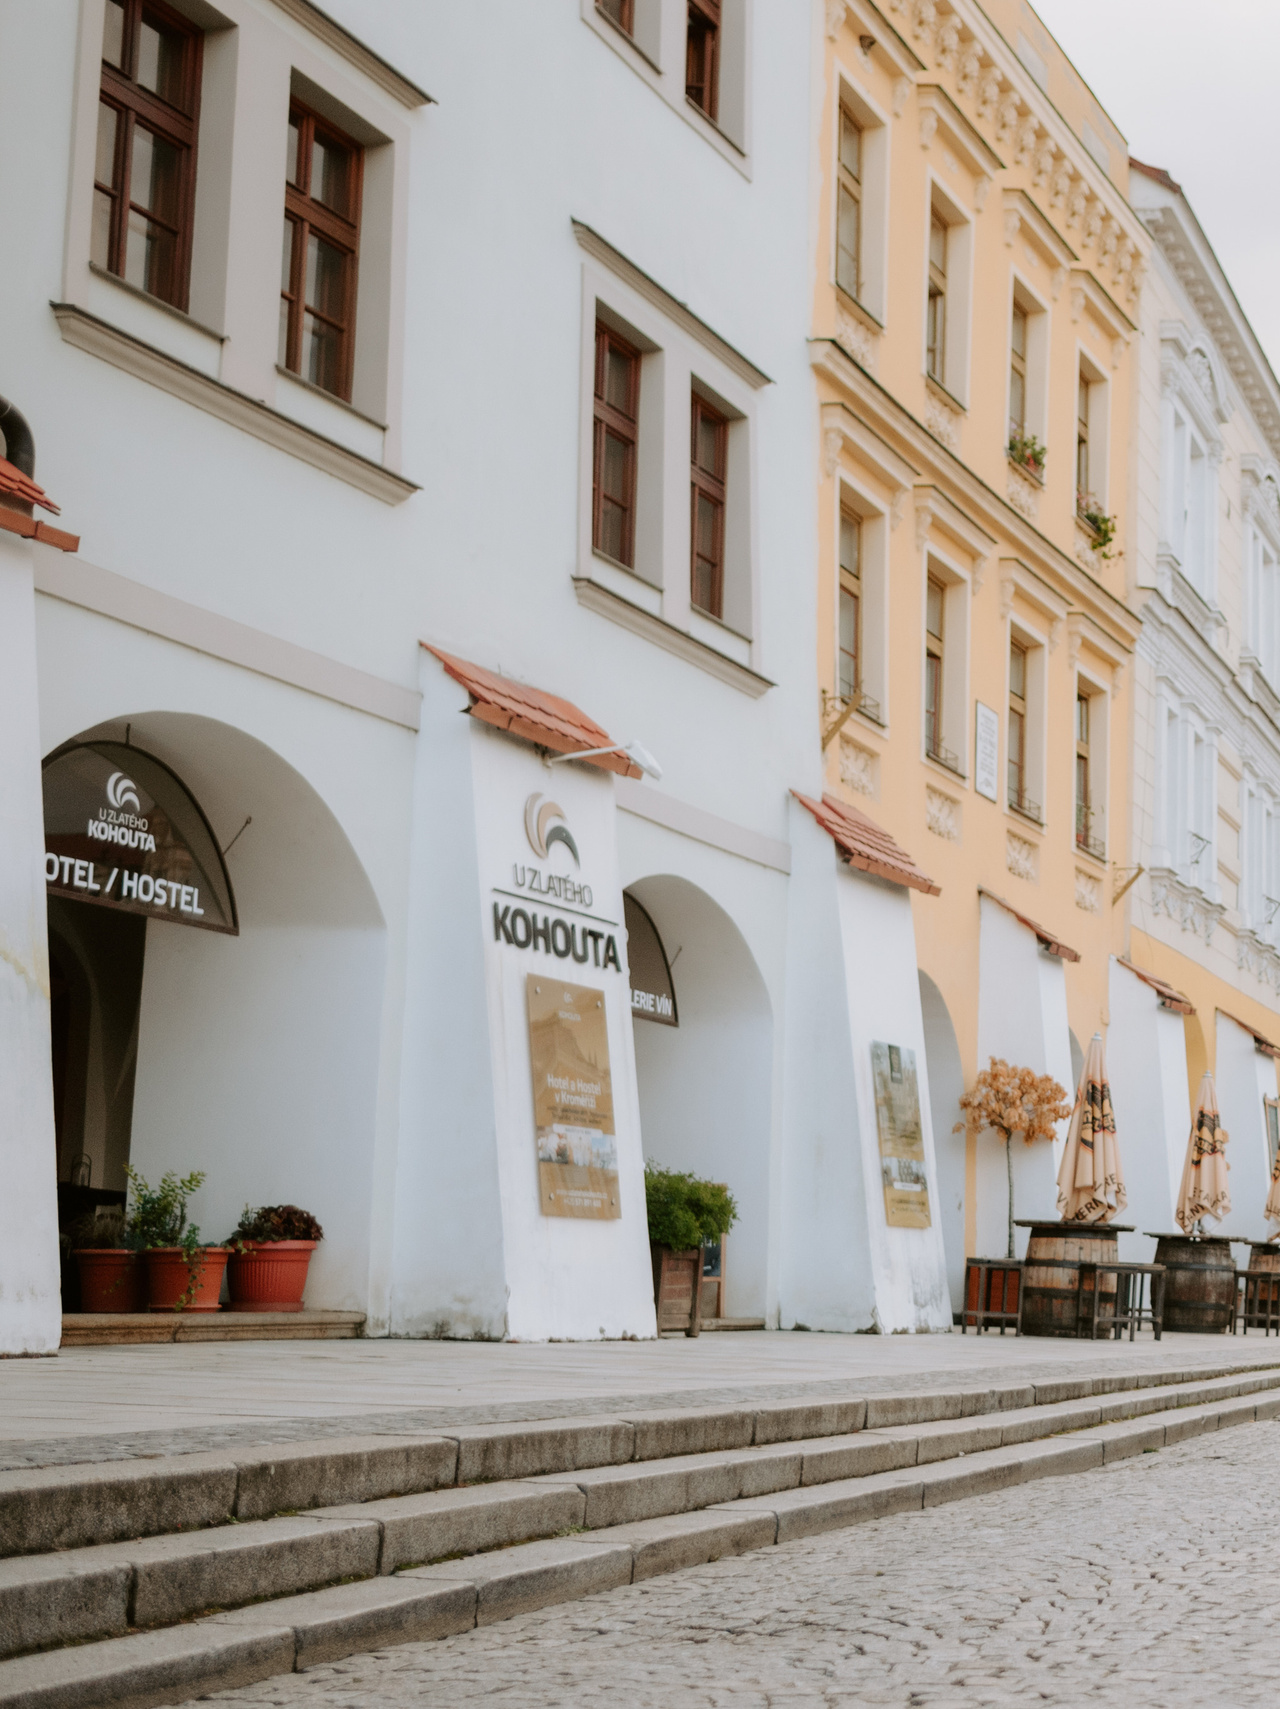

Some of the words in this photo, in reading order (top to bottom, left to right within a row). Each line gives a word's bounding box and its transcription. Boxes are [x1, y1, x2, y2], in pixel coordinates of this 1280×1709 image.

[99, 806, 107, 821] U
[107, 809, 149, 831] ZLATÉHO
[87, 818, 157, 853] KOHOUTA
[121, 869, 205, 915] HOSTEL
[512, 862, 526, 888] U
[526, 866, 594, 908] ZLATÉHO
[492, 901, 622, 973] KOHOUTA
[655, 993, 673, 1017] VÍN
[546, 1072, 570, 1091] Hotel
[570, 1080, 576, 1093] a
[576, 1077, 602, 1097] Hostel
[554, 1092, 560, 1104] v
